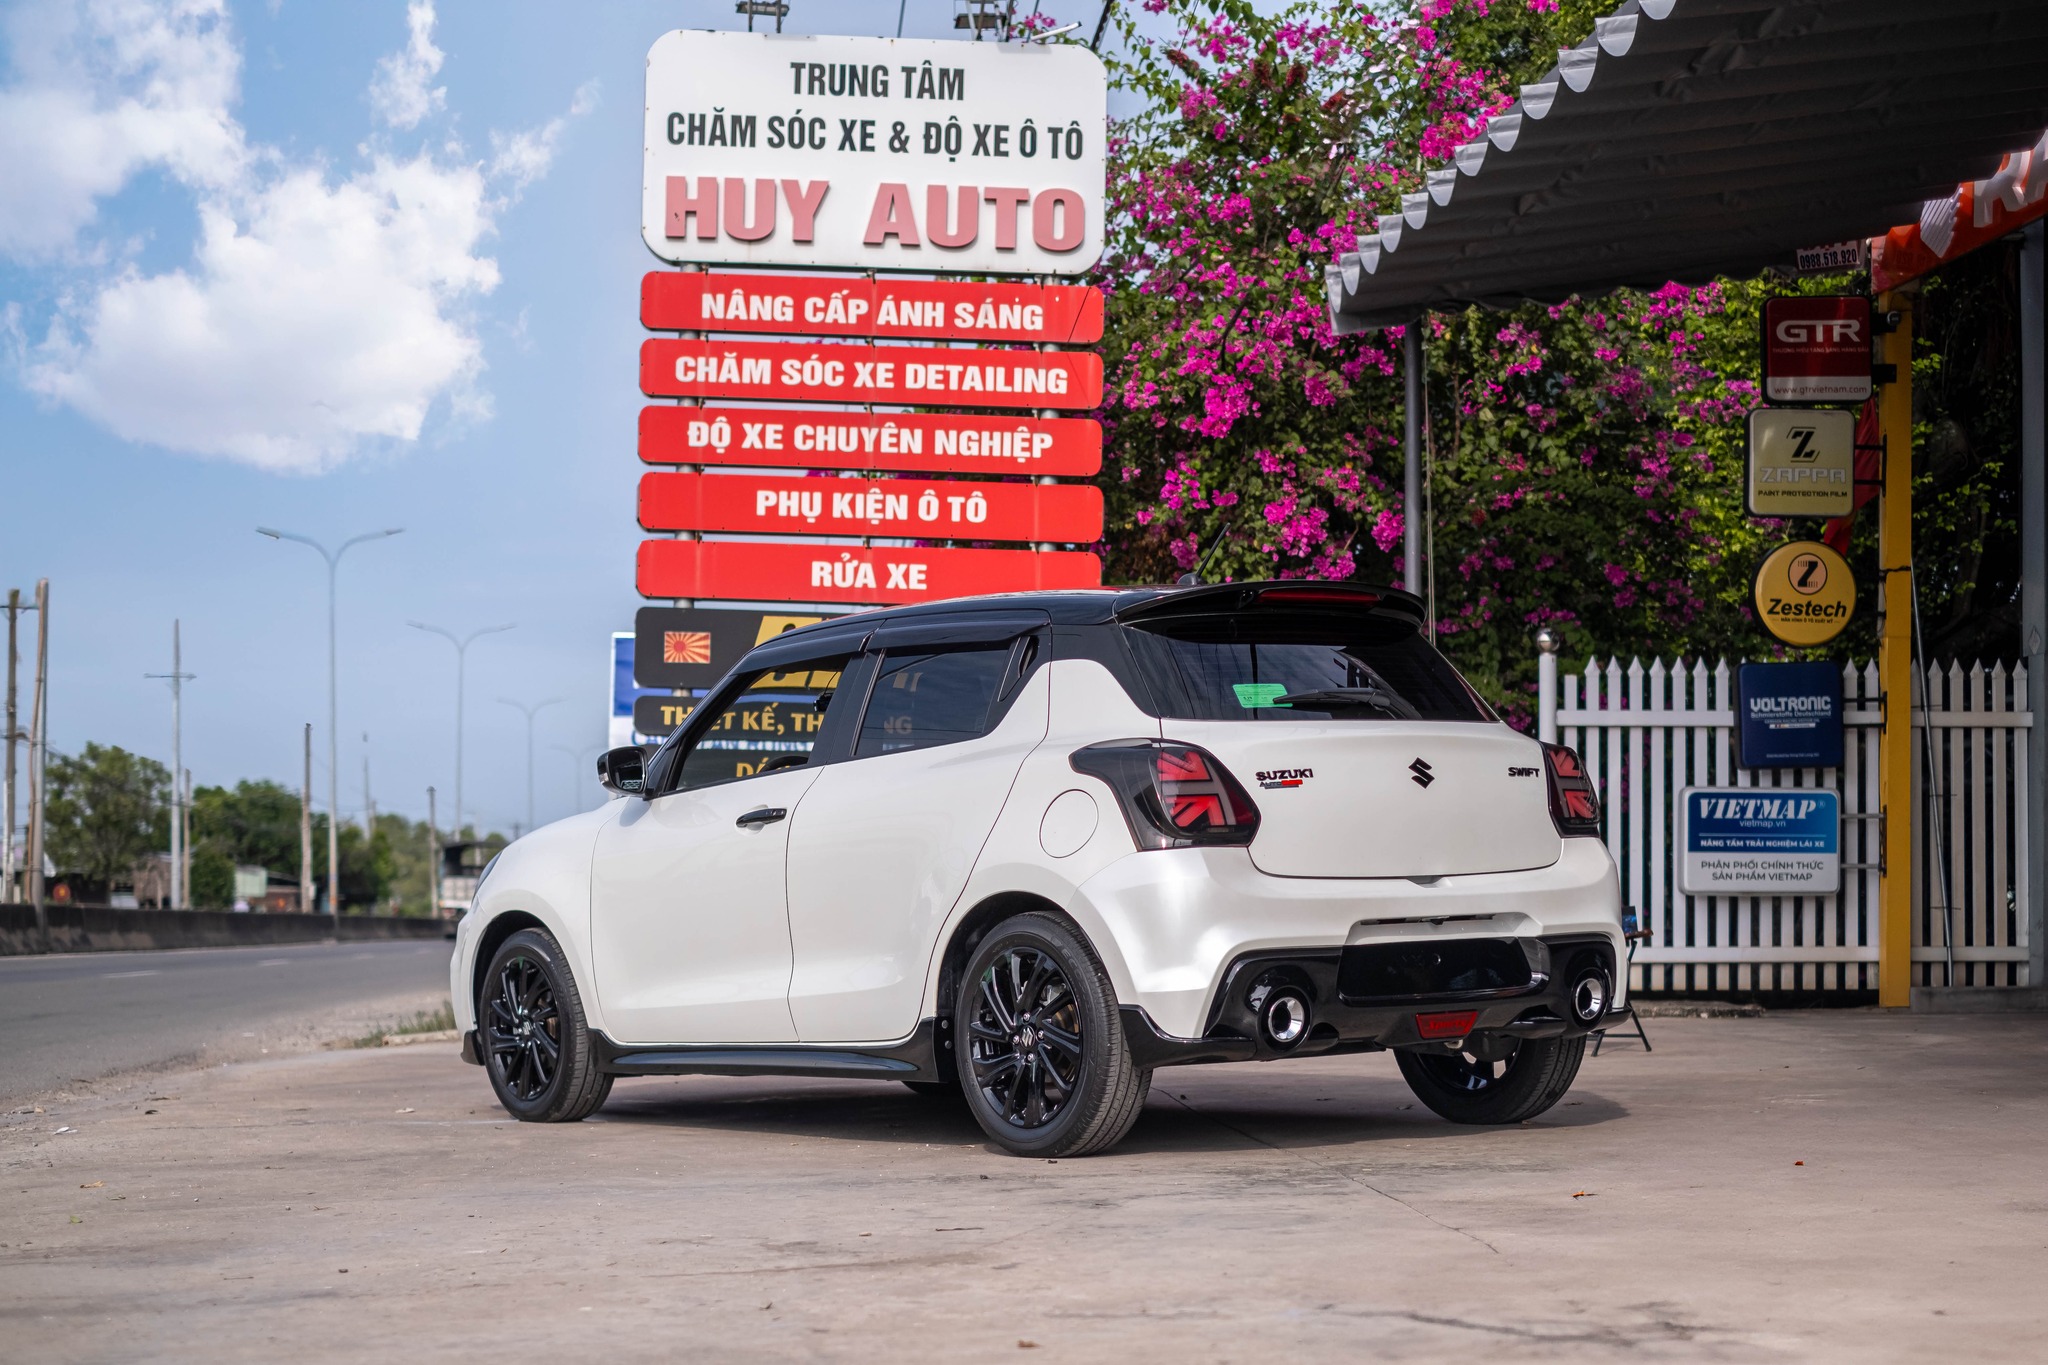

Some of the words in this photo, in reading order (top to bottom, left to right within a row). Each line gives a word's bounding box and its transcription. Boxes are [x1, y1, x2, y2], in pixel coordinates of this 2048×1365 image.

[791, 63, 888, 97] TRUNG
[902, 60, 964, 100] TÂM
[668, 107, 756, 147] CHĂM
[768, 109, 825, 149] SÓC
[839, 119, 875, 152] XE
[889, 122, 909, 153] &
[924, 116, 961, 162] ĐỘ
[972, 124, 1009, 157] XE
[1020, 119, 1036, 157] Ô
[1048, 121, 1082, 160] TÔ
[663, 174, 831, 244] HUY
[861, 180, 1087, 253] AUTO
[1800, 249, 1856, 268] 0988.518.920
[702, 289, 793, 321] NÂNG
[805, 290, 868, 324] CẤP
[877, 295, 944, 327] ÁNH
[952, 303, 1045, 332] SÁNG
[1776, 320, 1860, 343] GTR
[676, 352, 771, 384] CHĂM
[781, 354, 844, 386] SÓC
[854, 362, 894, 388] XE
[906, 364, 1067, 394] DETAILING
[1774, 386, 1867, 394] www.gtrvietnam.com
[687, 416, 731, 453] ĐỘ
[742, 423, 783, 449] XE
[794, 422, 922, 454] CHUYÊN
[935, 426, 1053, 463] NGHIỆP
[1760, 467, 1846, 484] ZAPPA
[757, 490, 822, 523] PHỤ
[833, 488, 908, 524] KIỆN
[918, 489, 939, 521] Ô
[947, 491, 987, 523] TÔ
[812, 553, 876, 588] RỬA
[886, 563, 927, 590] XE
[1767, 599, 1847, 617] Zestech
[1750, 696, 1831, 711] VOLTRONIC
[742, 702, 785, 735] KẾ,
[1256, 769, 1313, 781] SUZUKI
[1508, 766, 1539, 777] SWIFT
[1740, 820, 1786, 828] vietmap.vn
[1701, 839, 1724, 847] NÂNG
[1766, 839, 1797, 848] NGHIỆM
[1701, 859, 1730, 869] PHÂN
[1734, 860, 1758, 869] PHỐI
[1761, 860, 1793, 869] CHÍNH
[1796, 860, 1824, 870] THỨC
